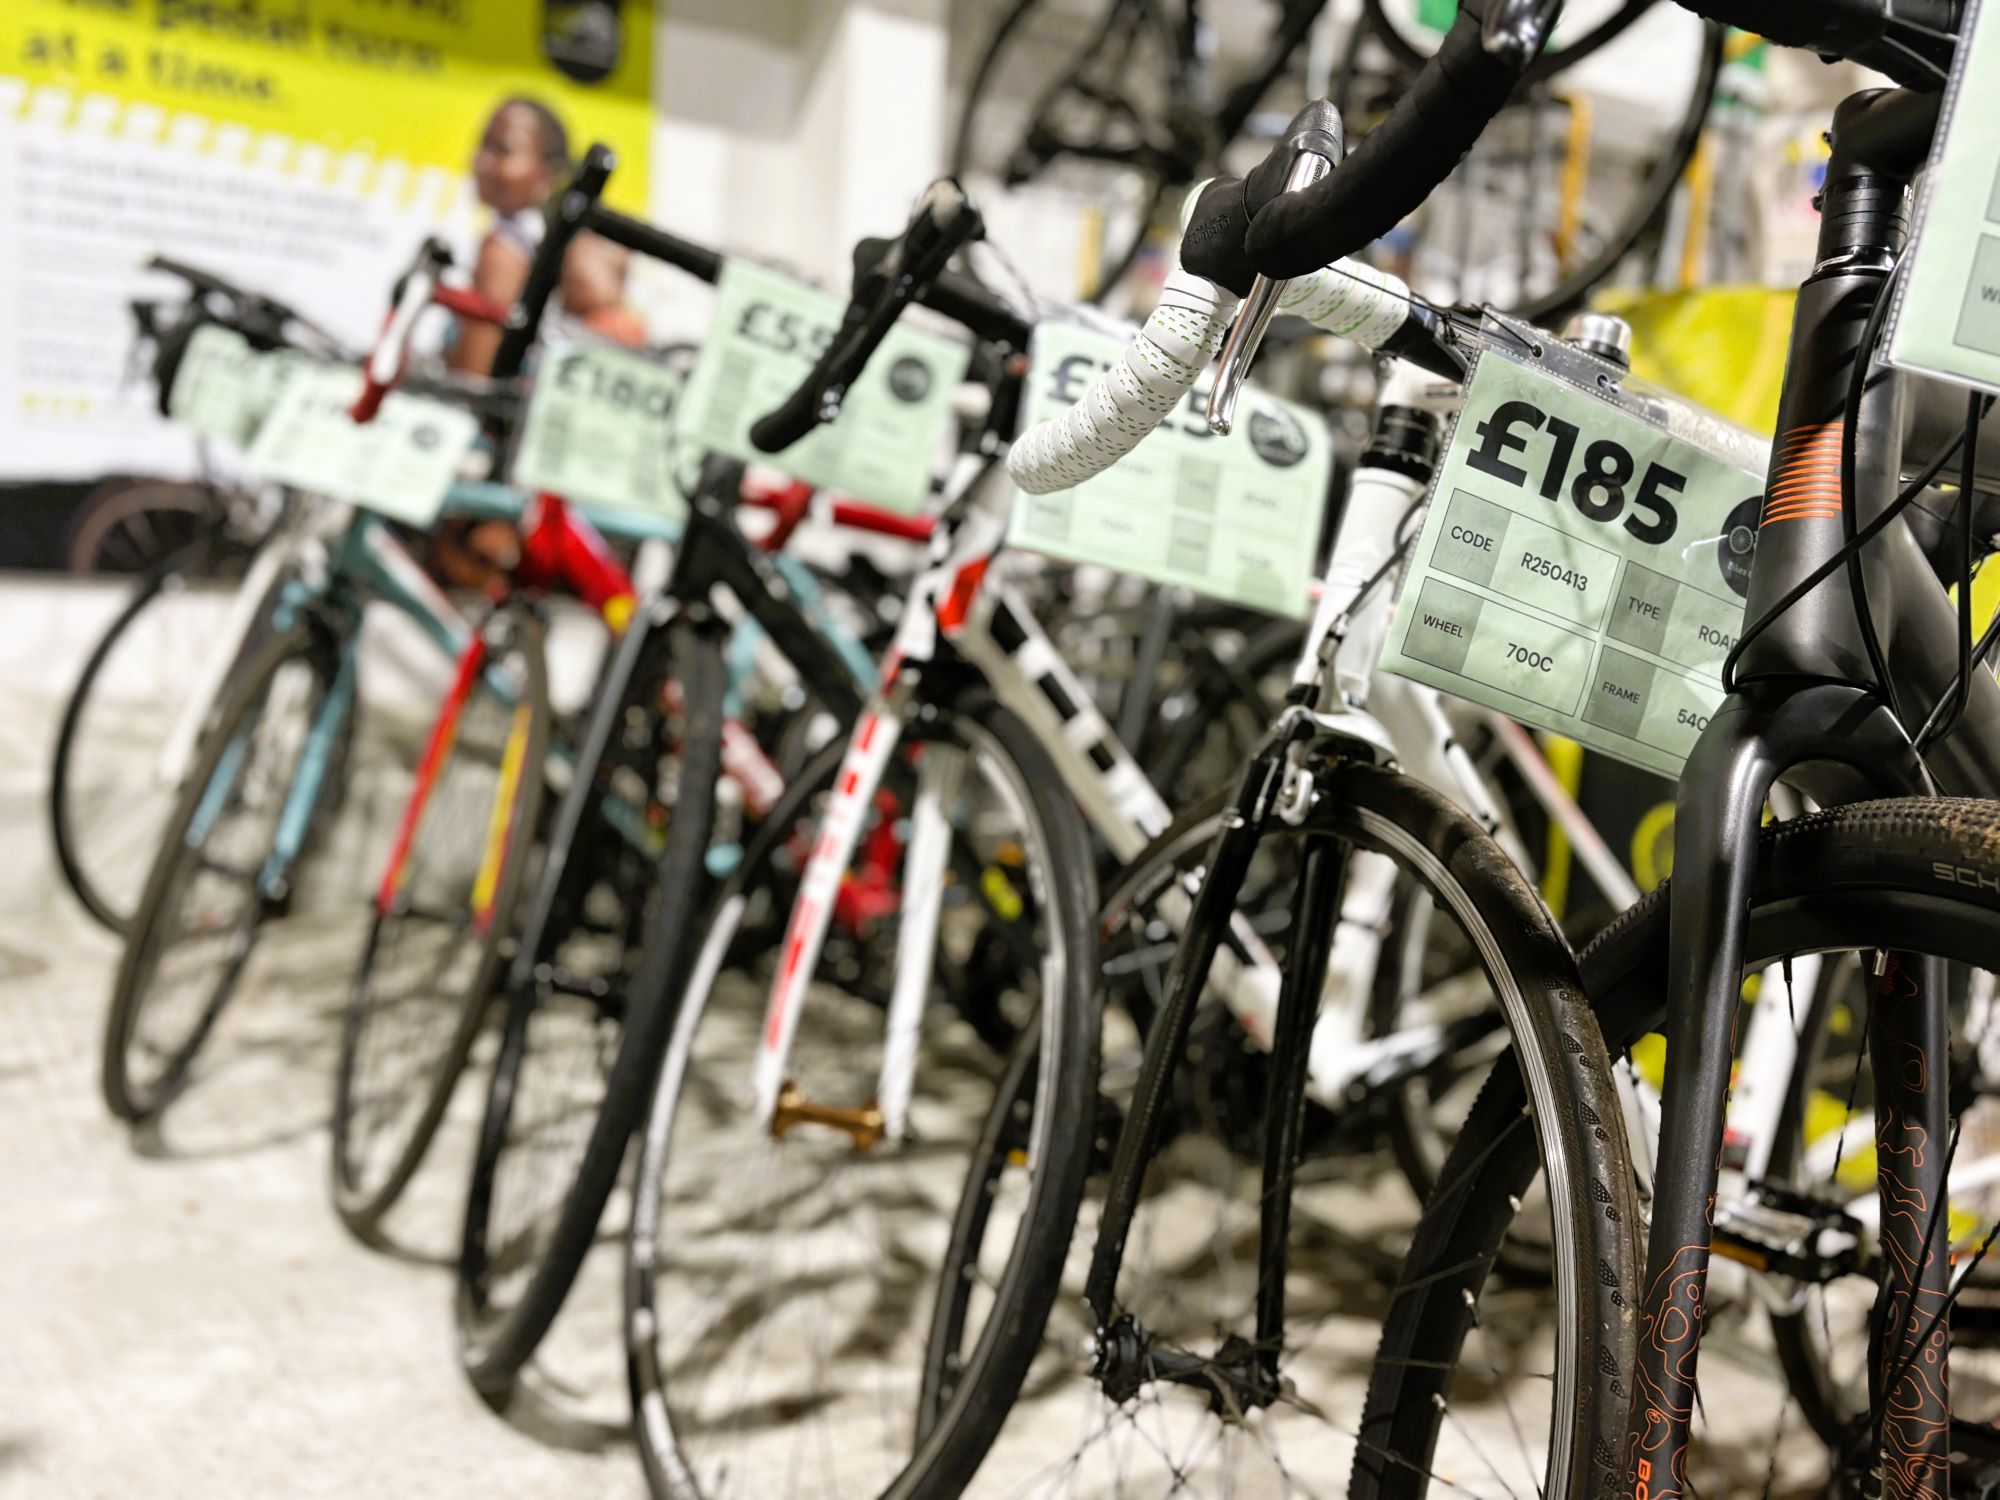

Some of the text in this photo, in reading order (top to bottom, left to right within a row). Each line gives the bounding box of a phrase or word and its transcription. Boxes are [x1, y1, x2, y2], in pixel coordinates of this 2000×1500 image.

[1465, 400, 1688, 546] £185
[1450, 525, 1588, 592] CODE R250413
[1628, 596, 1661, 620] TYPE
[1423, 613, 1554, 673] WHEEL 700C
[1602, 682, 1641, 705] FRAME
